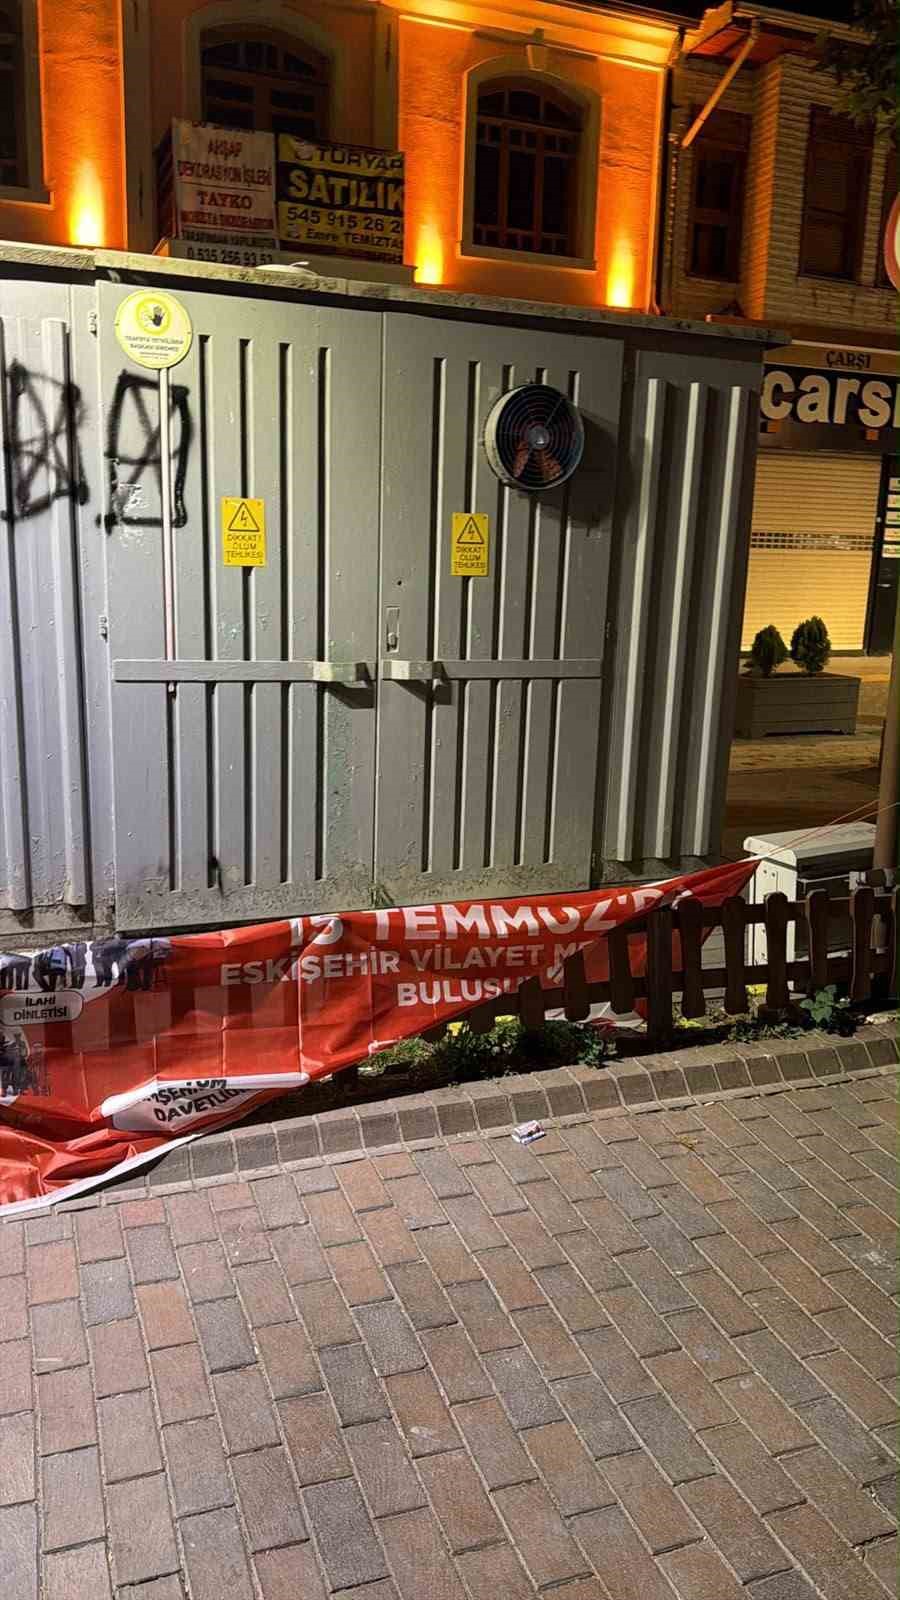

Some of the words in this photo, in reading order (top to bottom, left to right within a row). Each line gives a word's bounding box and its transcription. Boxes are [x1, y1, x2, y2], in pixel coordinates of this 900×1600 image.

[197, 190, 253, 209] TAYKO
[288, 169, 403, 210] SATILIK
[287, 207, 320, 225] 545
[327, 211, 357, 229] 915
[220, 945, 401, 986] ESKİŞEHİR
[410, 943, 545, 973] VİLAYET
